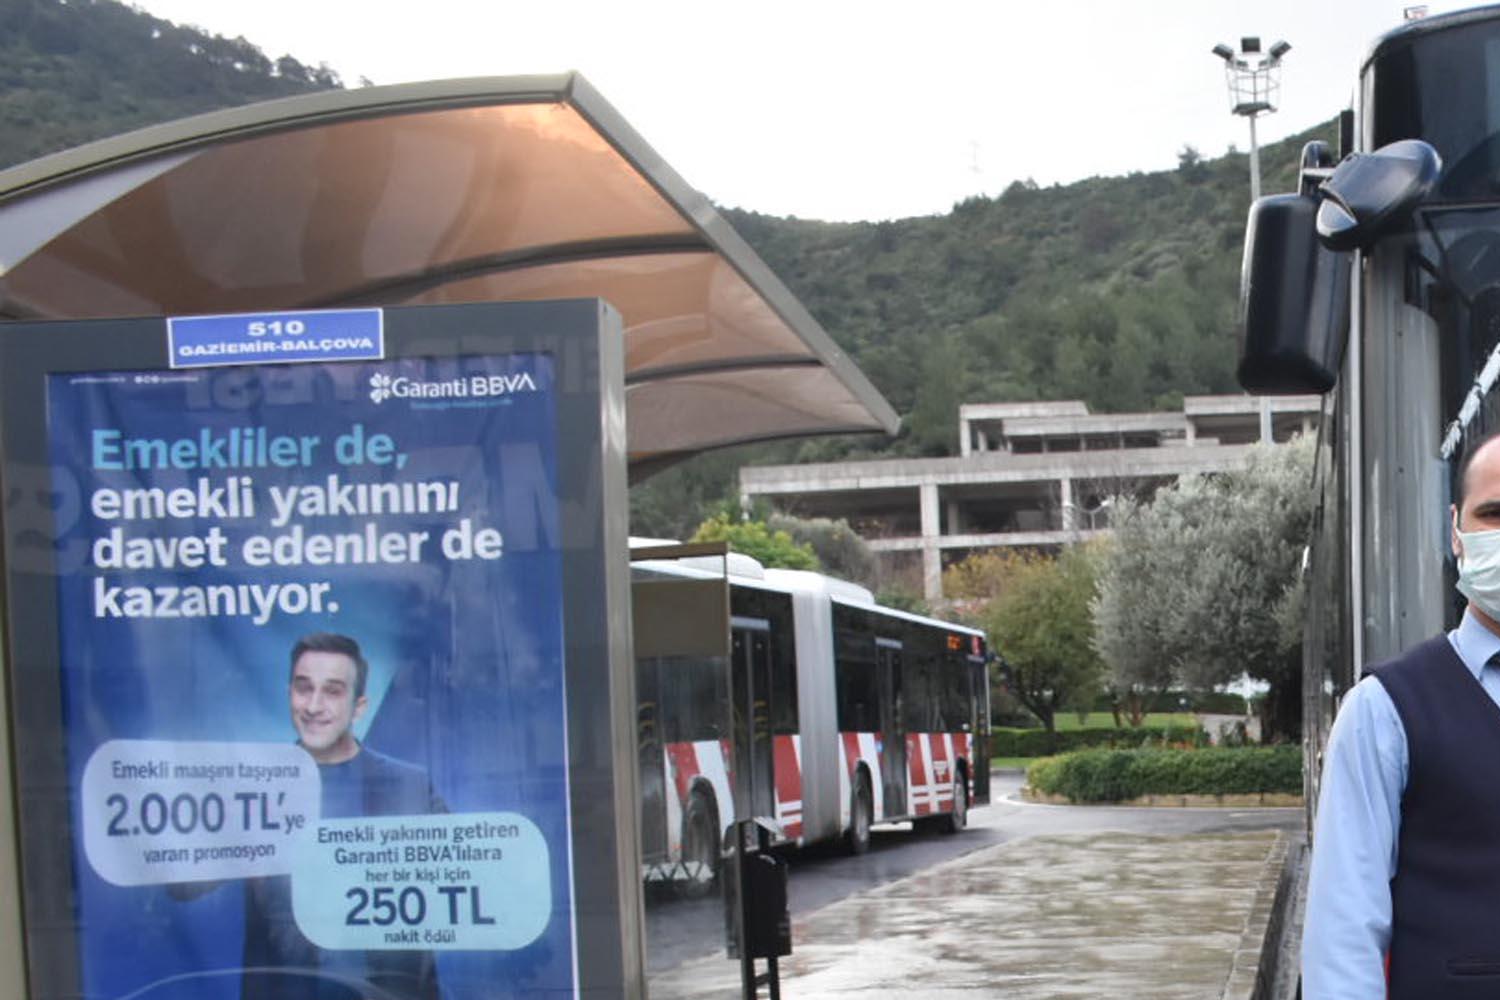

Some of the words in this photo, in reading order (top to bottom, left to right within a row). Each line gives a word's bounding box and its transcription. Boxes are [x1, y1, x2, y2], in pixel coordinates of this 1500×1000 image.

[247, 320, 305, 337] 510
[178, 337, 373, 357] GAZİEMİR-BALÇOVA
[391, 376, 468, 398] Garanti
[471, 372, 537, 396] BBVA
[91, 427, 319, 470] Emekliler
[334, 424, 409, 469] de,
[91, 476, 255, 519] emekli
[269, 474, 459, 527] yakınını
[92, 526, 228, 570] davet
[242, 523, 430, 566] edenler
[441, 518, 503, 561] de
[93, 576, 339, 626] kazanıyor.
[111, 760, 169, 780] Emekli
[174, 763, 234, 783] maaşını
[238, 761, 300, 783] taşıyana
[106, 792, 225, 837] 2.000
[317, 826, 375, 844] Emekli
[379, 826, 448, 846] yakınını
[452, 821, 520, 844] getiren
[143, 846, 189, 864] varan
[193, 842, 276, 864] promosyon
[334, 846, 400, 865] Garanti
[404, 845, 503, 864] BBVA'lılara
[364, 868, 388, 883] her
[393, 867, 411, 882] bir
[415, 867, 441, 885] kişi
[444, 866, 471, 884] için
[344, 885, 427, 927] 250
[437, 885, 497, 926] TL
[384, 929, 420, 944] nakit
[424, 928, 457, 944] ödül
